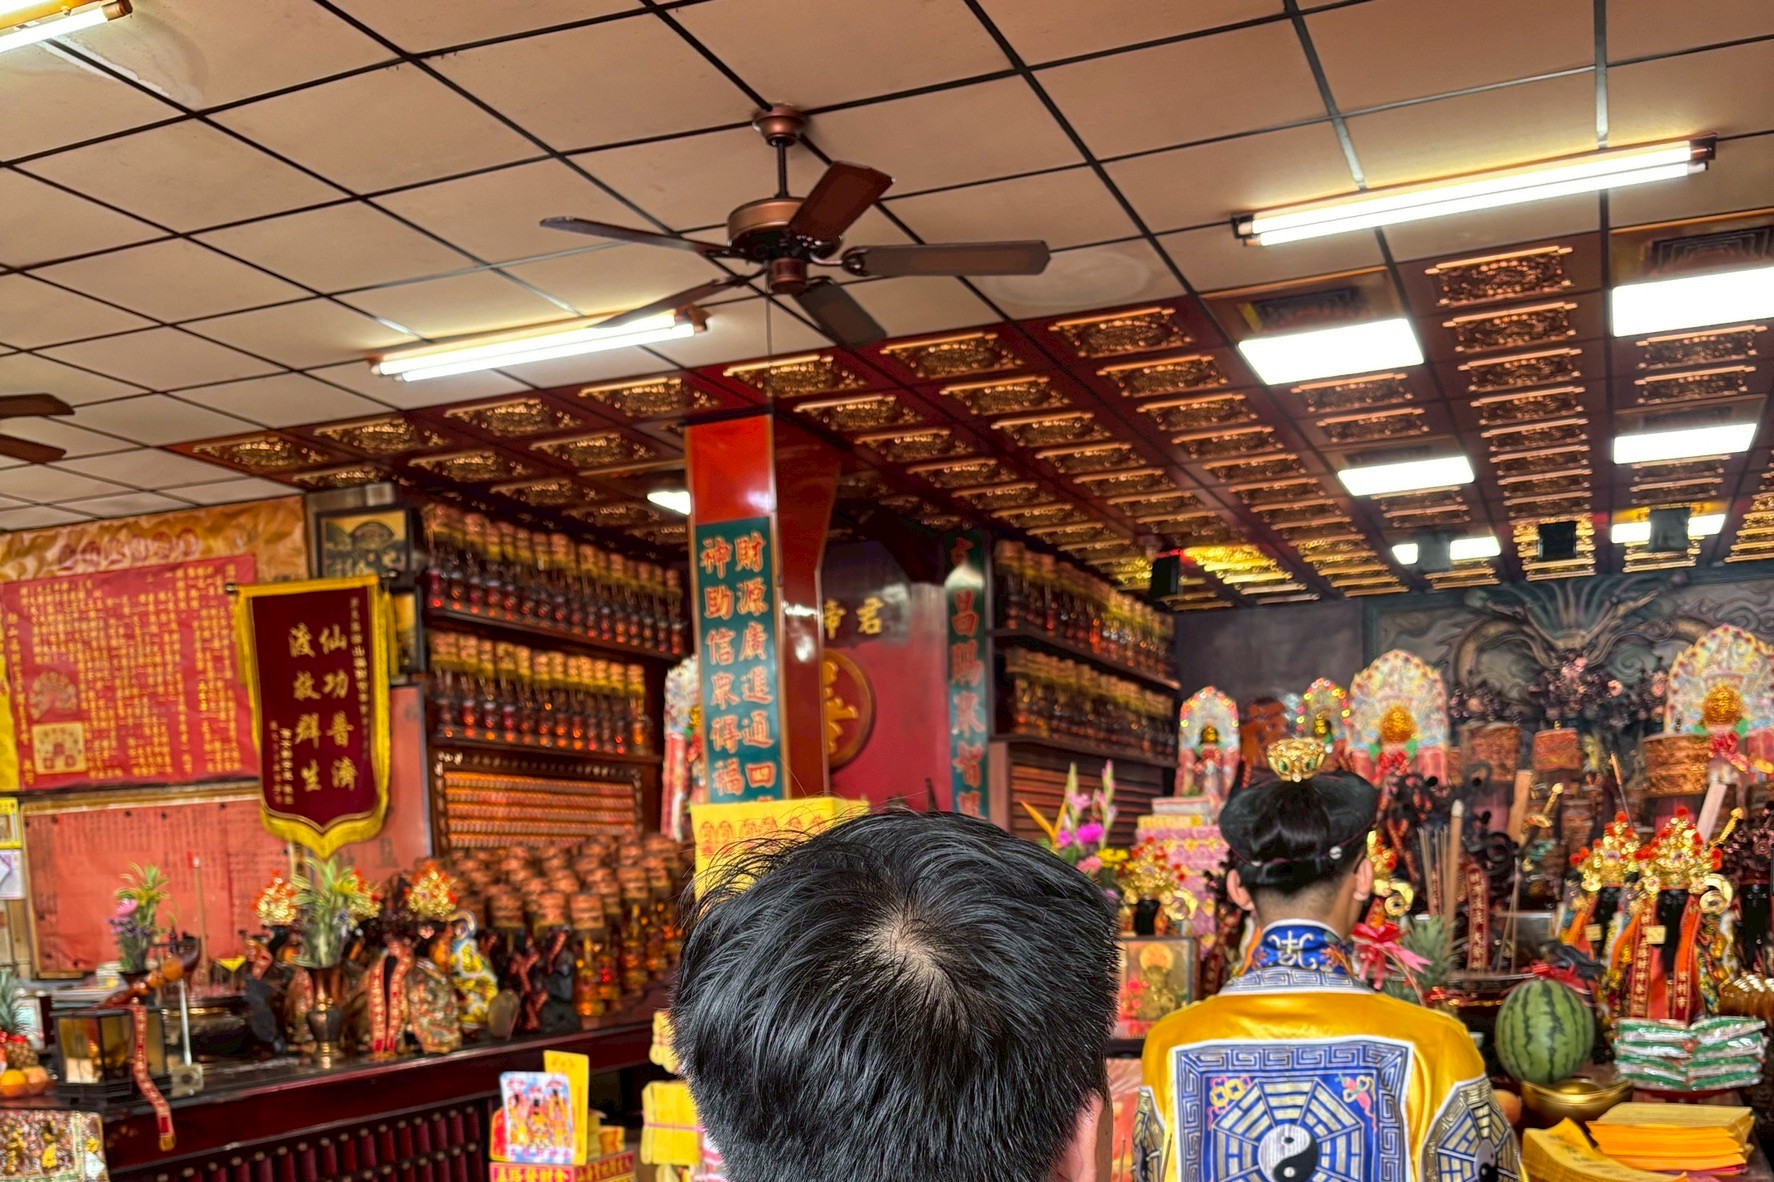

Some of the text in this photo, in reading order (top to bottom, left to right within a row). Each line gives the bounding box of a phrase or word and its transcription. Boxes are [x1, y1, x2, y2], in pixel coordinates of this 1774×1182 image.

[734, 531, 776, 800] 財源廣進通四
